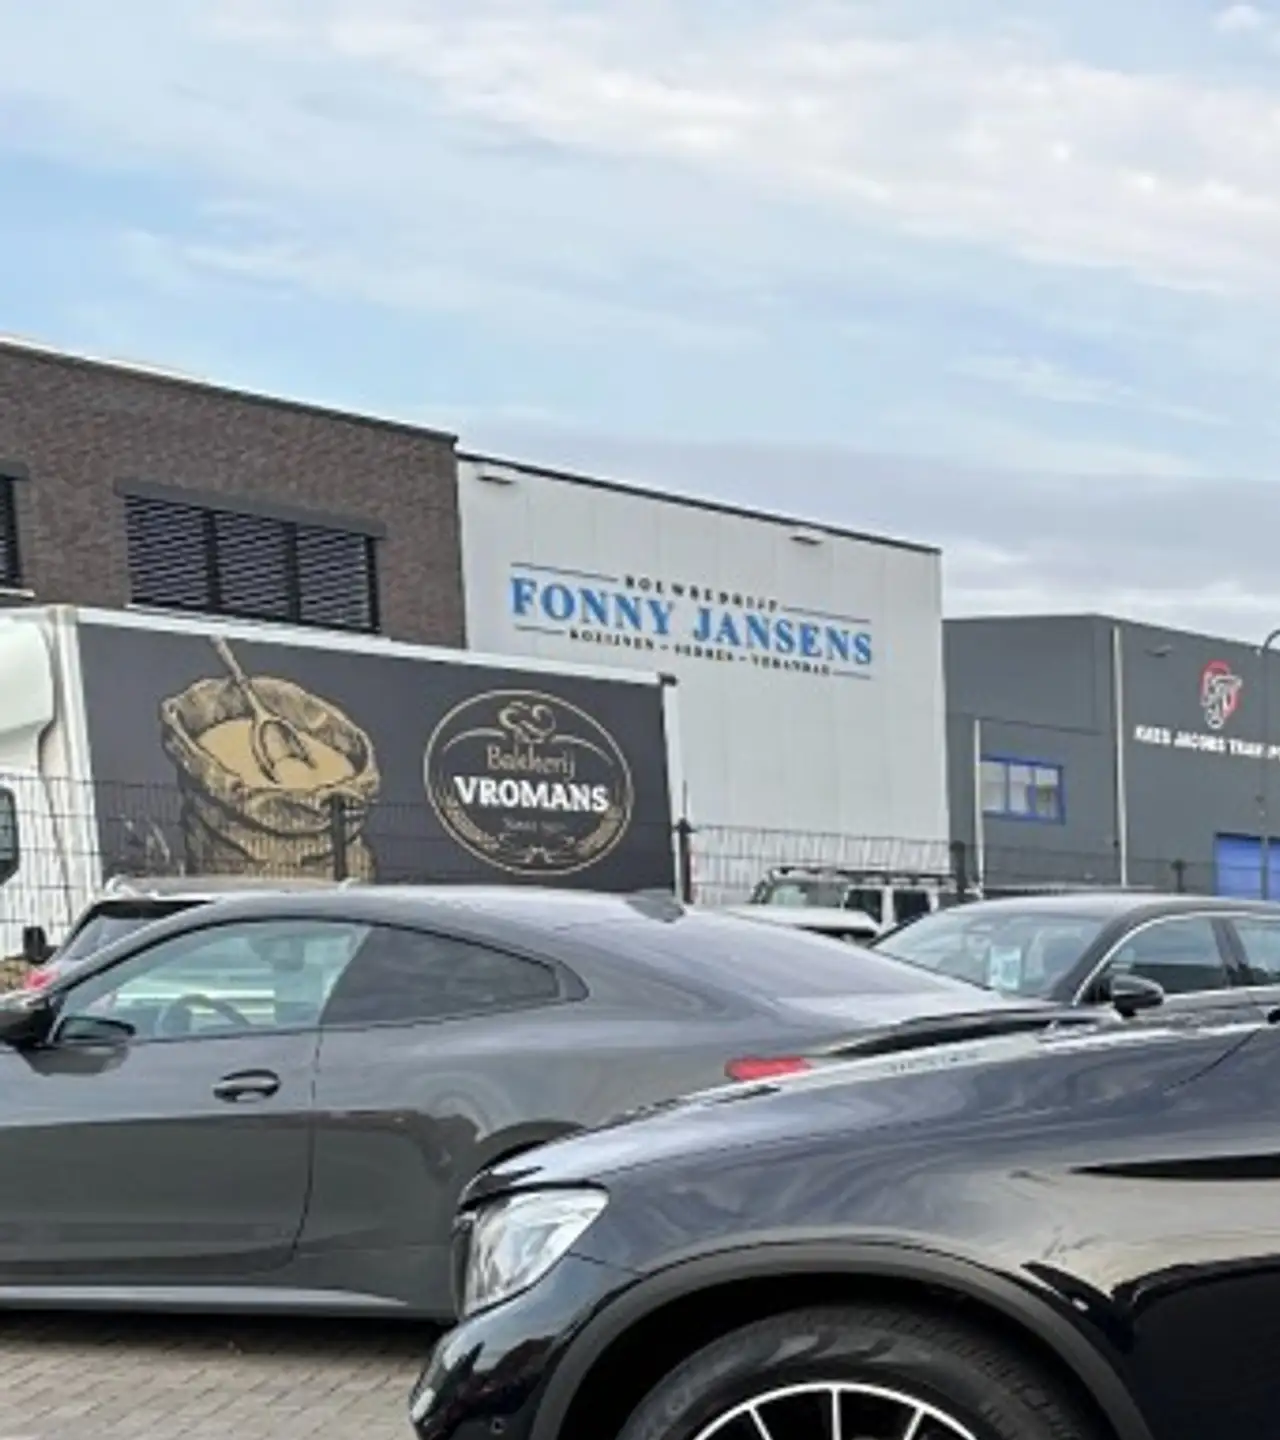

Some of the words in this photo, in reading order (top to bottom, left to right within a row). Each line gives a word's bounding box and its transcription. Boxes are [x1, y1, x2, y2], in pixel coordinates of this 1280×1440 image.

[510, 577, 675, 635] FONNY
[692, 607, 874, 665] JANSENS
[487, 742, 577, 783] Bakkerij
[453, 776, 610, 812] VROMANS
